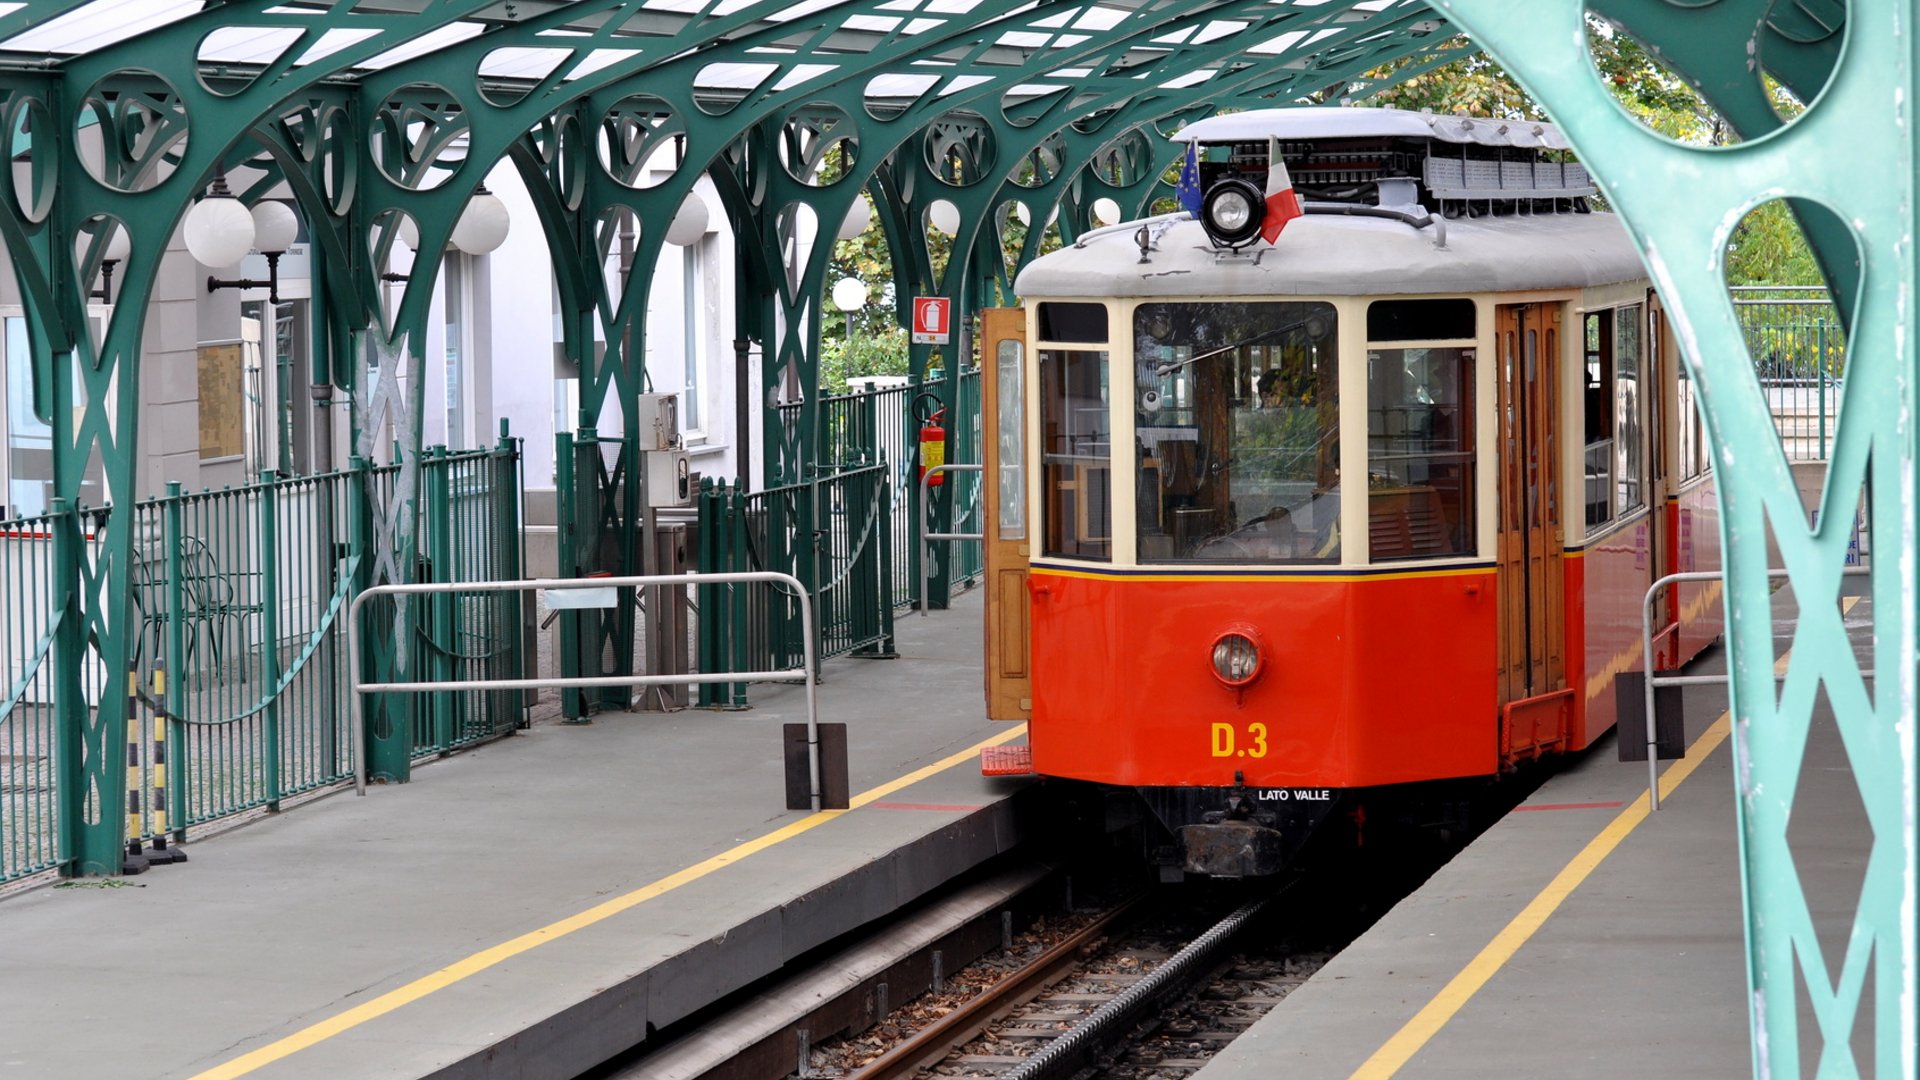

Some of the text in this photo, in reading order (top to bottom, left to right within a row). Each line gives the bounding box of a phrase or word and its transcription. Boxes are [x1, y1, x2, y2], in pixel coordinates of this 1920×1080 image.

[1211, 722, 1268, 758] D.3
[1258, 790, 1330, 801] LATO VALLE
